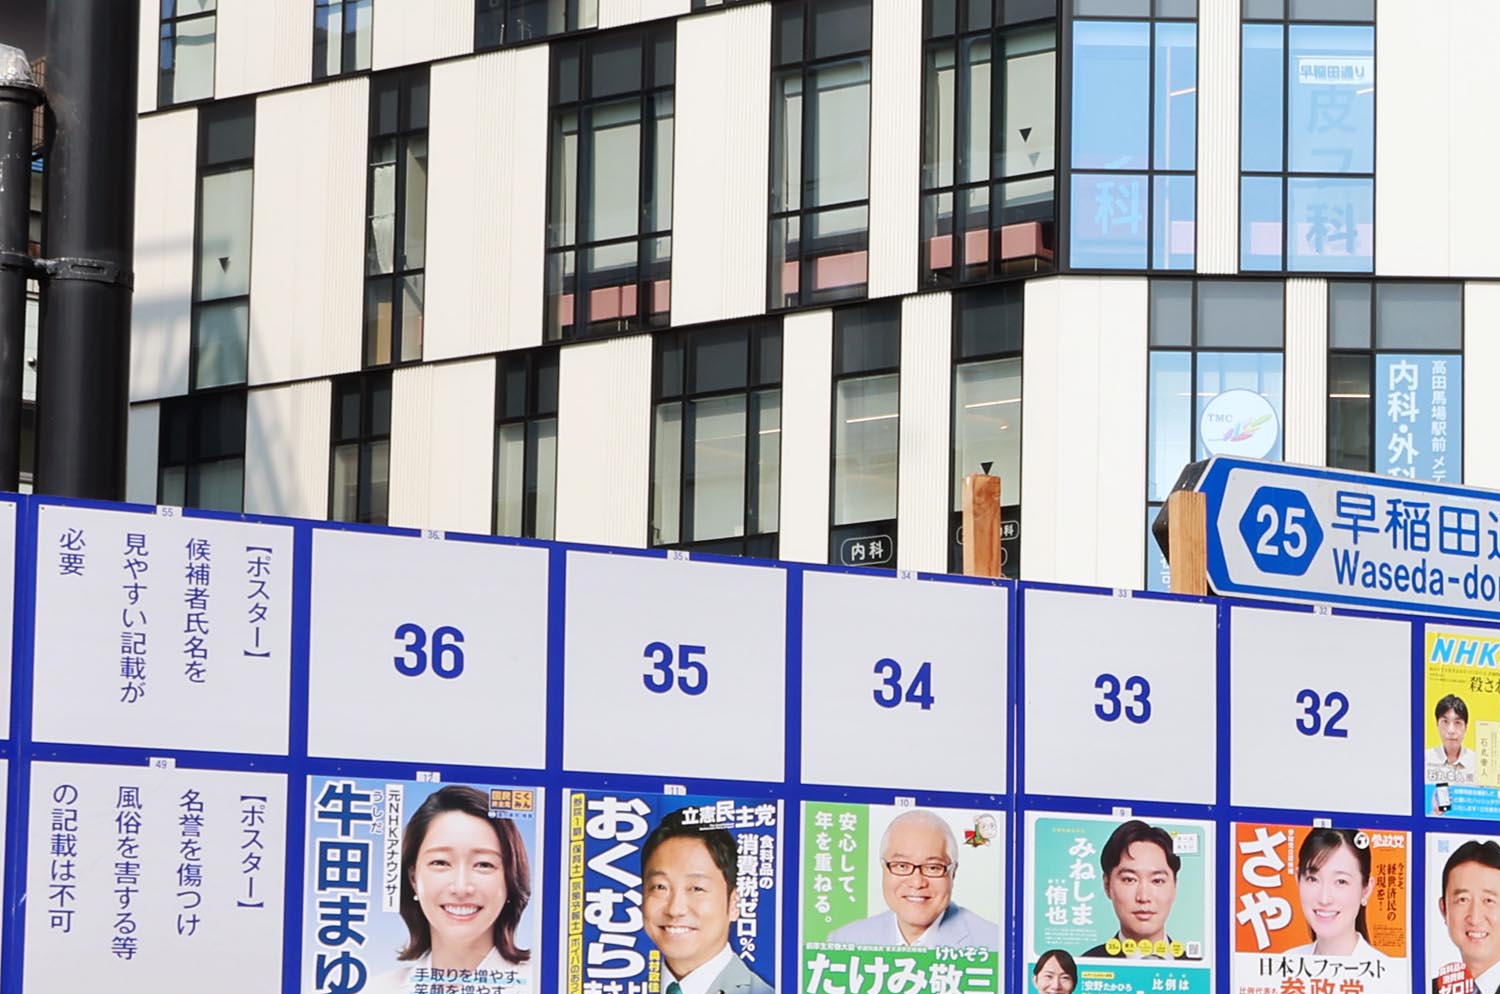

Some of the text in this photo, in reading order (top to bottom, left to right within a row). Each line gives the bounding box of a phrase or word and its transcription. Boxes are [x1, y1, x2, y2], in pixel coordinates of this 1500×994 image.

[1207, 413, 1233, 423] TMC
[1431, 360, 1447, 452] 高田馬場駅前
[58, 527, 86, 576] 必要
[851, 540, 884, 561] 内科
[1256, 504, 1307, 558] 25
[119, 532, 148, 703] 見やすい記載が
[184, 537, 211, 682] 候補者氏名を
[243, 544, 273, 658] 【ポスター】
[393, 622, 464, 678] 36
[642, 641, 708, 695] 35
[872, 657, 934, 710] 34
[1093, 673, 1151, 723] 33
[1295, 688, 1349, 737] 32
[371, 791, 383, 834] うしだ
[681, 800, 776, 828] 立憲民主党
[48, 783, 79, 933] の記載は不可
[176, 788, 204, 935] 名誉を傷つけ
[237, 794, 267, 908] 【ポスター】
[386, 790, 400, 907] 元NHKアナウンサー
[759, 834, 774, 889] 食料品の
[814, 811, 833, 924] 年を重ねる。
[838, 812, 858, 903] 安心して、
[1371, 833, 1404, 849] 参政党
[111, 785, 142, 960] 風俗を害する等
[584, 796, 651, 979] おくむら
[736, 833, 759, 963] 消費税ゼロ％へ
[1069, 837, 1096, 926] みねしま
[1236, 827, 1293, 950] さや
[1387, 863, 1397, 921] 経世済民の
[1045, 885, 1068, 925] 侑也
[414, 967, 522, 985] 手取りを増やす、
[935, 946, 990, 962] けいぞう
[1259, 957, 1386, 978] 日本人ファースト
[1152, 978, 1190, 991] 比例は
